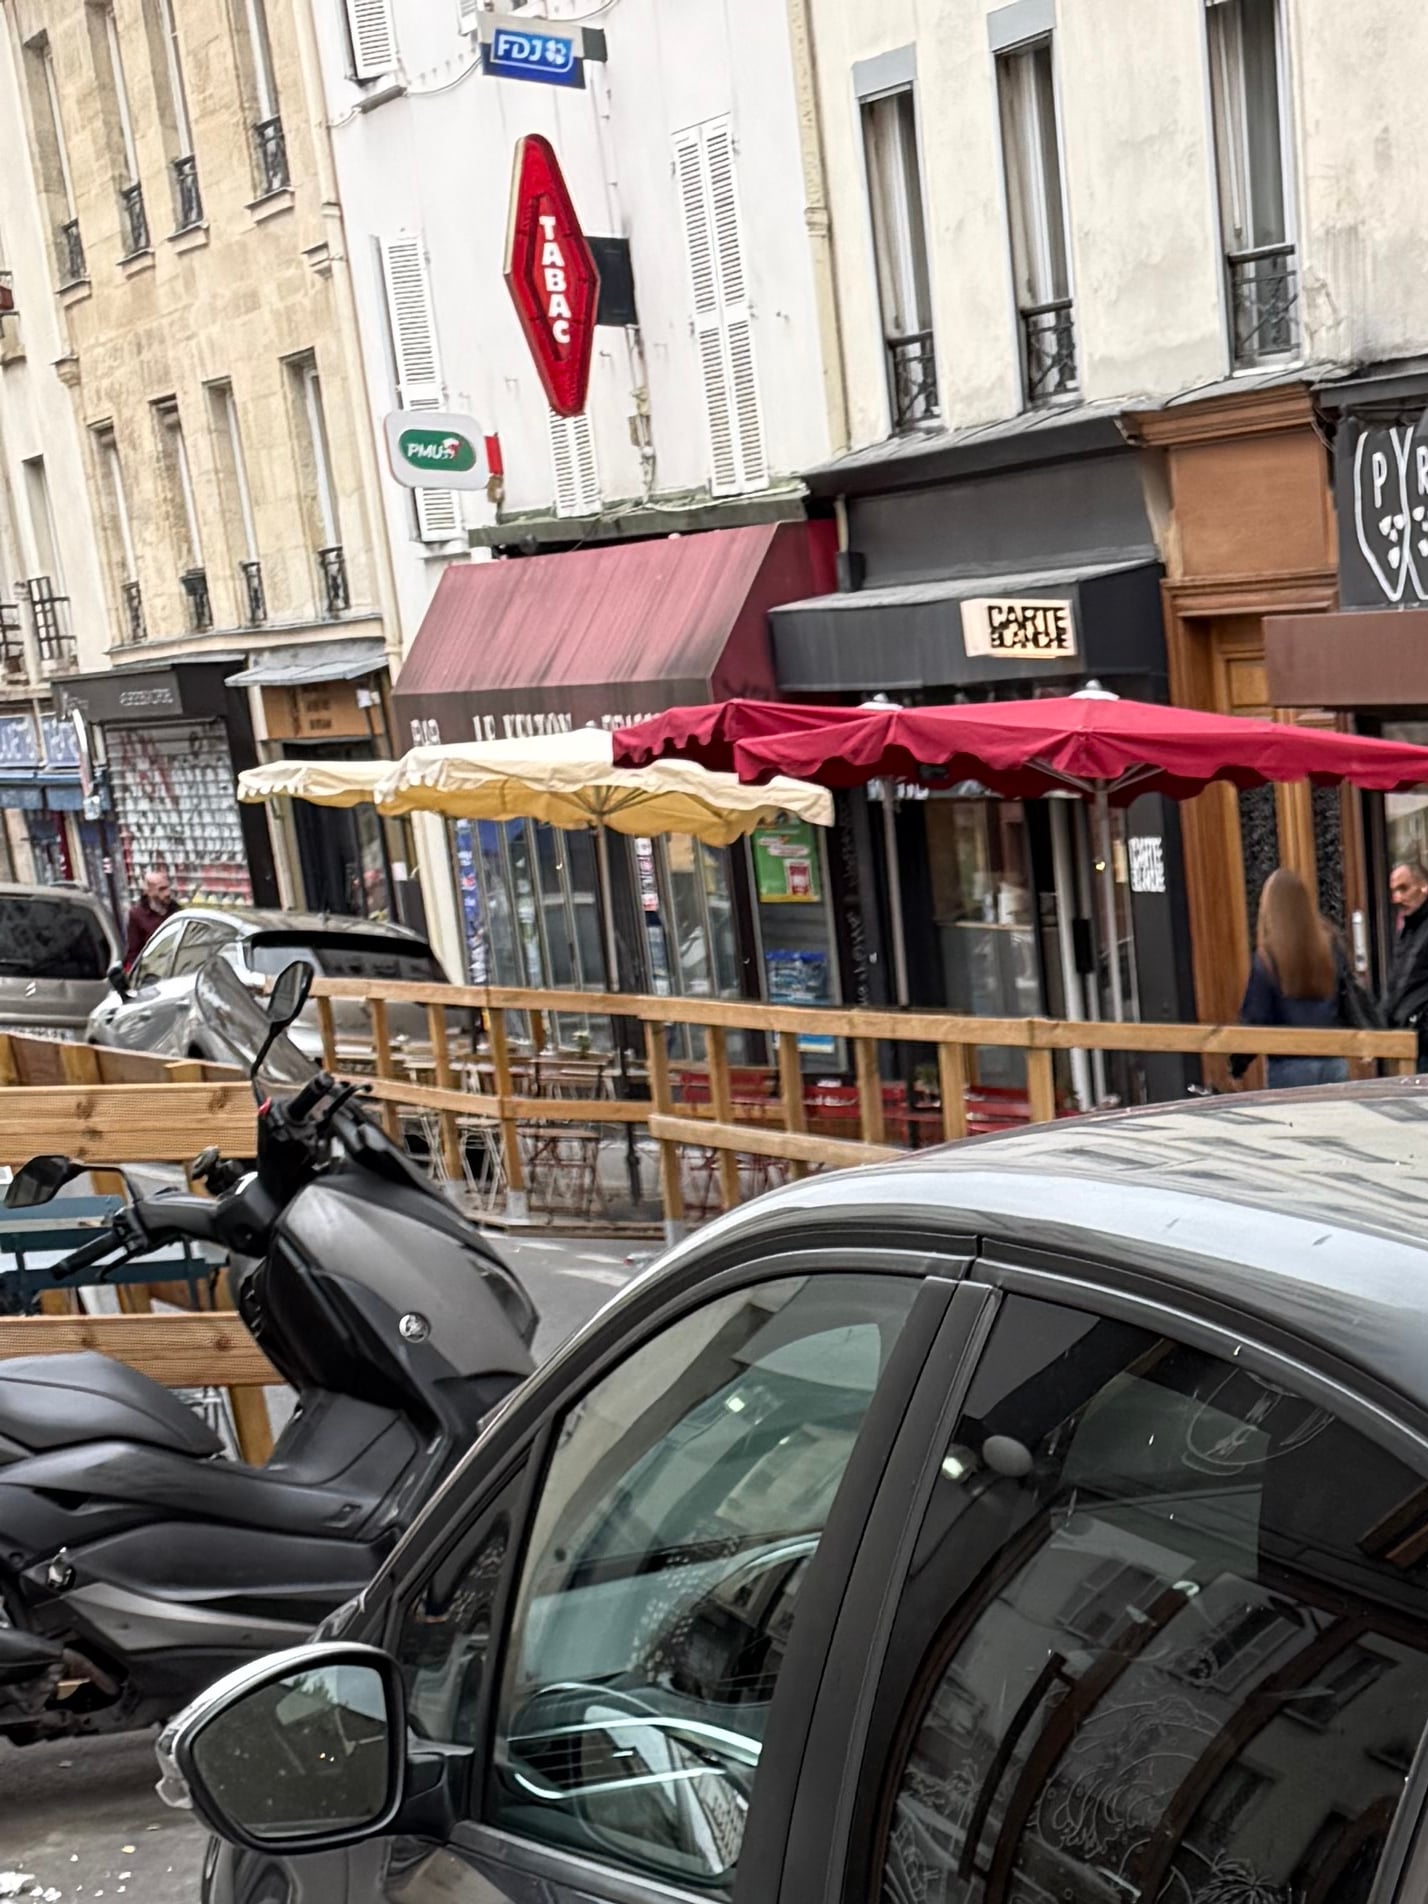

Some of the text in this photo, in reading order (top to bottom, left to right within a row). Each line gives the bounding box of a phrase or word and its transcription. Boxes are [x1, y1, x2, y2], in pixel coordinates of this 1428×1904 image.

[498, 34, 543, 61] FDJ
[539, 215, 572, 344] TABAC
[407, 443, 442, 460] PMU
[988, 605, 1067, 634] CARTE
